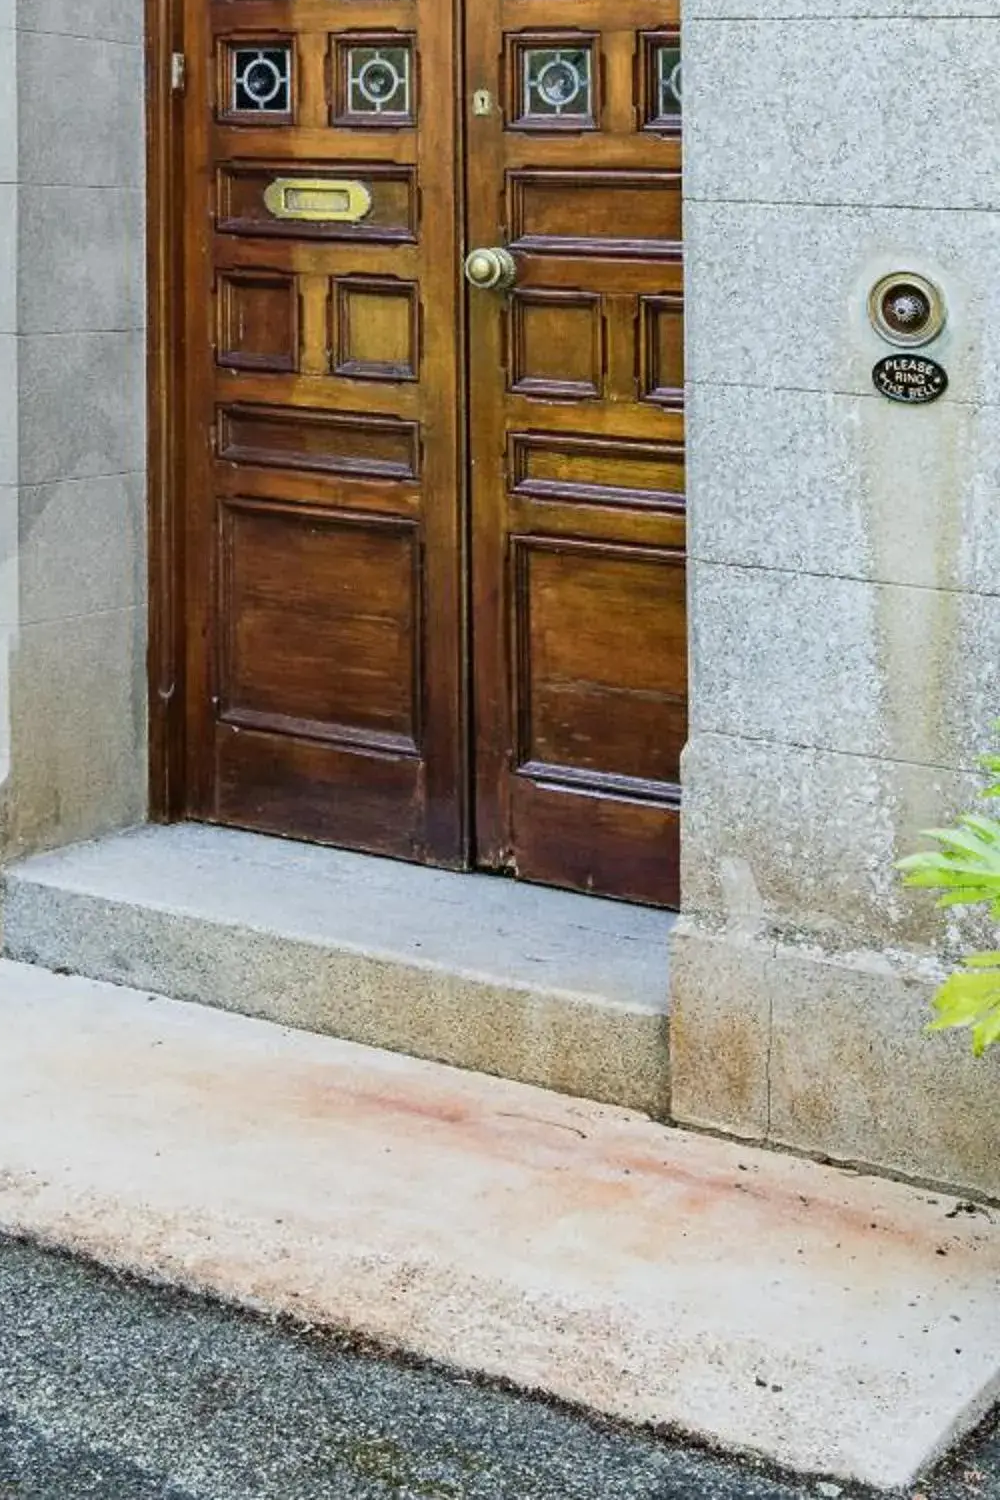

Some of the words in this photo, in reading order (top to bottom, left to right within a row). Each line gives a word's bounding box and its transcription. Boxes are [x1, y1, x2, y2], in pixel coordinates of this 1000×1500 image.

[885, 360, 934, 375] PLEASE
[895, 371, 925, 384] RING
[882, 378, 904, 392] THE
[908, 384, 937, 397] BELL
